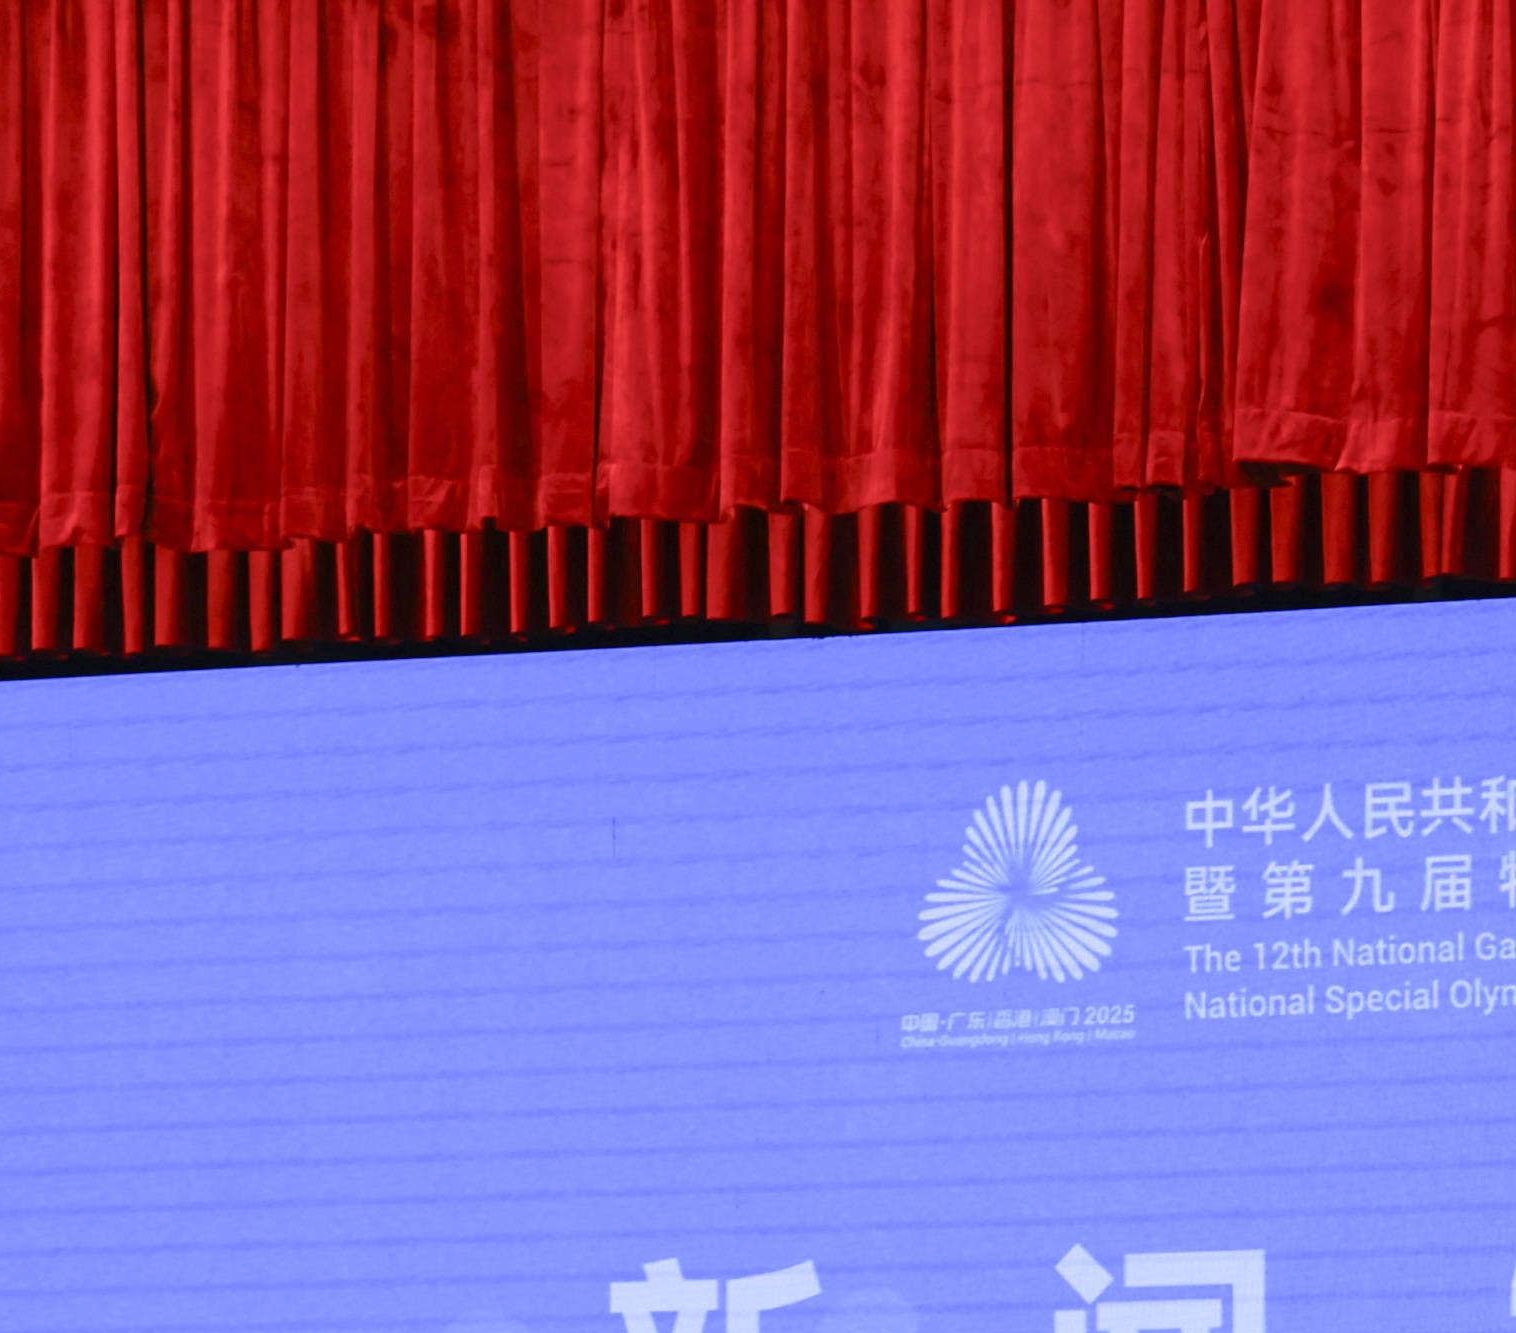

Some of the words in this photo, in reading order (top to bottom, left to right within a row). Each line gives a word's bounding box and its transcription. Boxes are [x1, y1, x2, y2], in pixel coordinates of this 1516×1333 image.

[1183, 943, 1241, 973] The
[1253, 938, 1322, 970] 12th
[1332, 931, 1464, 967] National
[1084, 1004, 1135, 1026] 2025
[1185, 984, 1315, 1020] National
[1325, 979, 1439, 1020] Special
